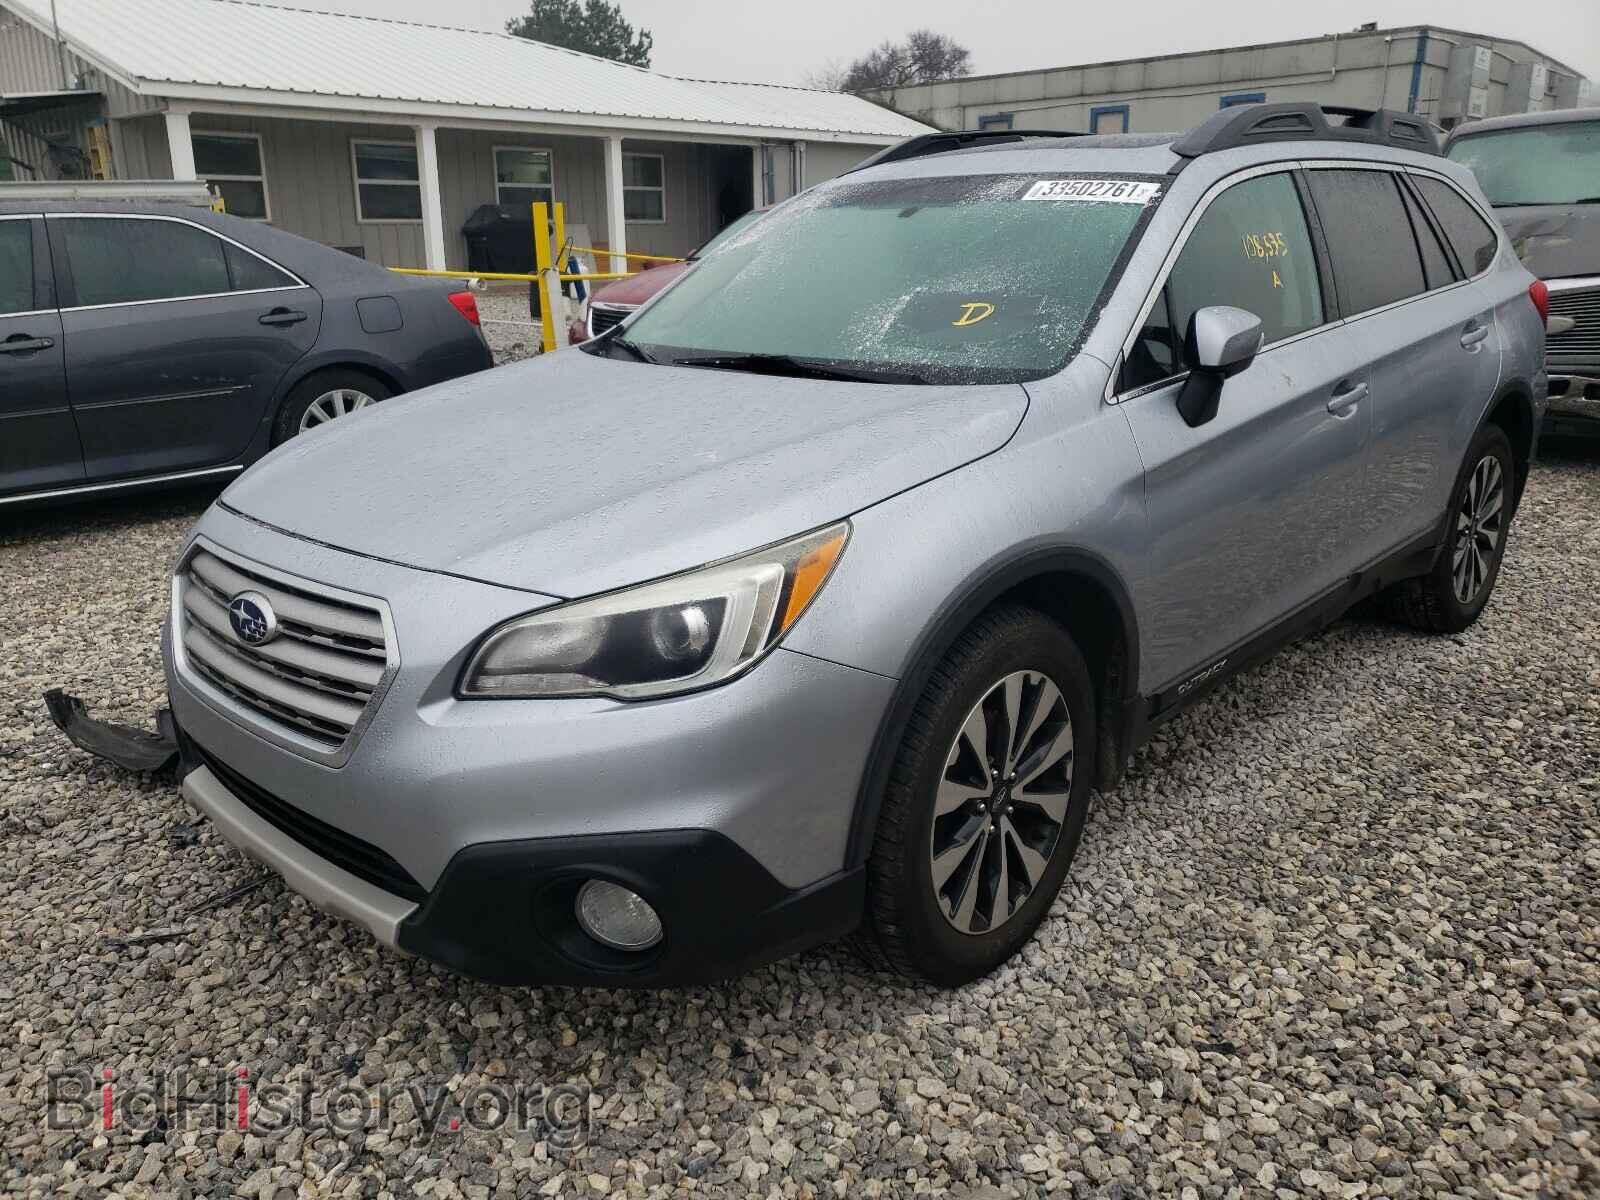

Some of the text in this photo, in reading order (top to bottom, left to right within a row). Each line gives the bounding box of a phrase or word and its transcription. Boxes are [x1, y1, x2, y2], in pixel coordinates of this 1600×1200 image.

[1043, 181, 1140, 197] 33502761
[1272, 271, 1284, 288] A
[952, 303, 994, 326] D
